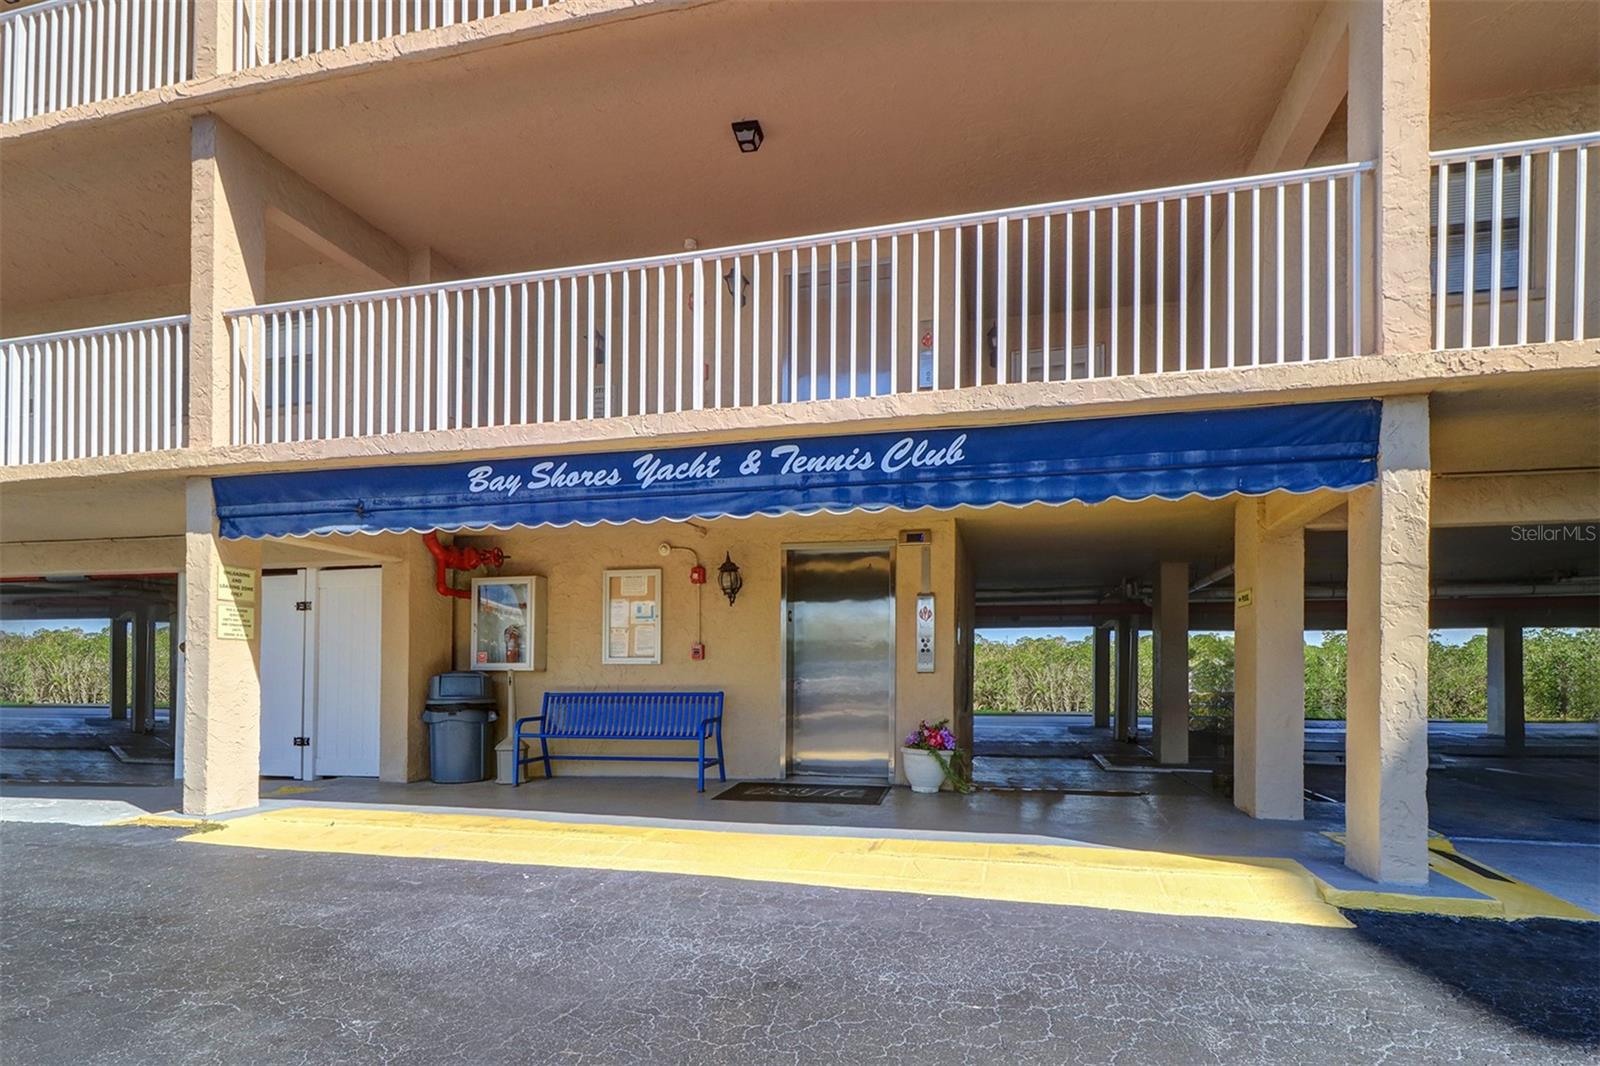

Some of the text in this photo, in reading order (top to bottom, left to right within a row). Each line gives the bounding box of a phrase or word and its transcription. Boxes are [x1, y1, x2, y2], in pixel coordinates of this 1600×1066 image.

[467, 434, 967, 497] Bay Shores Yacht & Tennis Club
